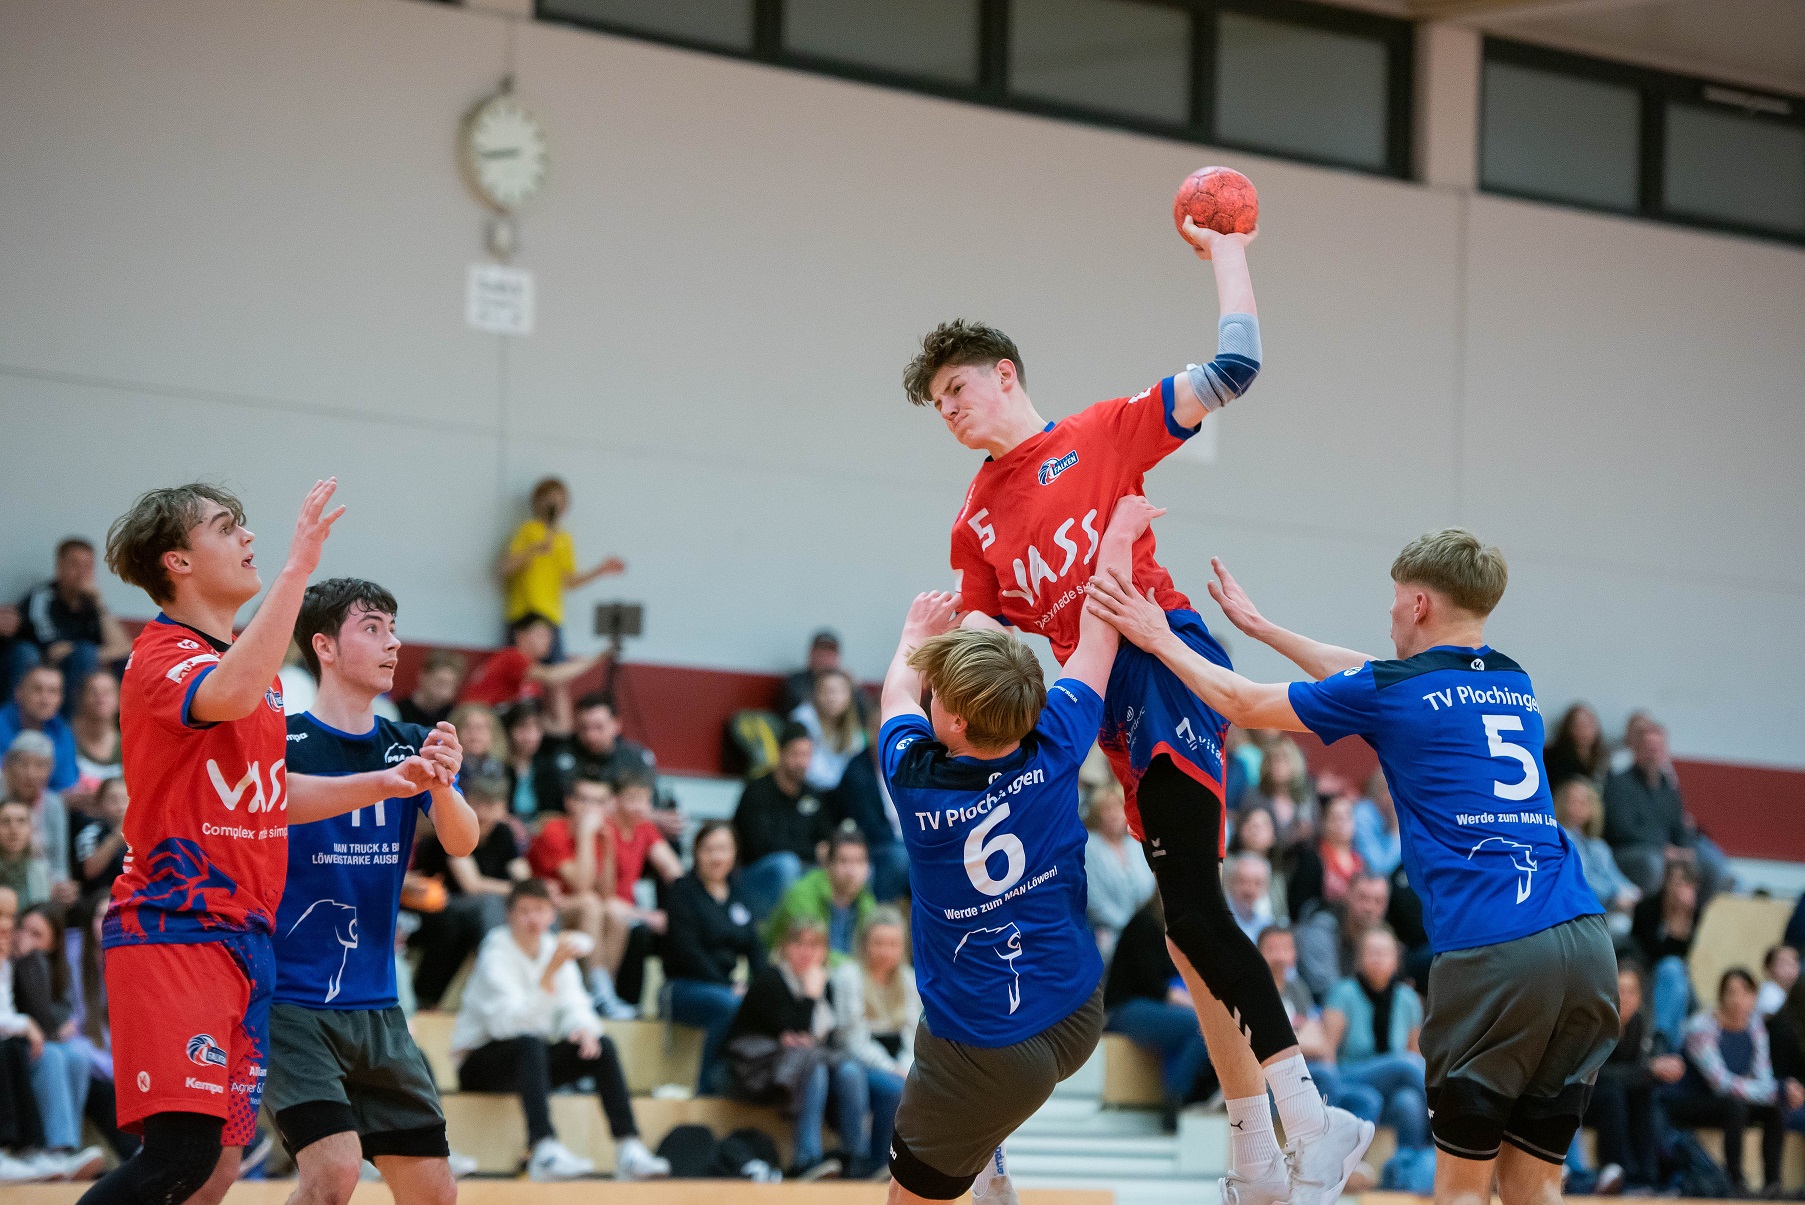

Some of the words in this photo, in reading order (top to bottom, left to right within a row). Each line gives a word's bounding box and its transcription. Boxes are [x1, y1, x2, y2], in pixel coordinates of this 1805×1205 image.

[1054, 455, 1077, 474] FALKEN
[967, 507, 996, 552] 5
[1002, 508, 1099, 607] VASS
[1423, 688, 1453, 711] TV
[1457, 686, 1542, 716] Plochinge
[1481, 714, 1540, 801] 5
[202, 822, 256, 839] Complex
[915, 810, 941, 831] TV
[1456, 812, 1495, 826] Werde
[1497, 814, 1519, 823] zum
[1521, 812, 1543, 824] MAN
[349, 843, 380, 853] TRUCK
[381, 843, 389, 853] &
[963, 801, 1026, 897] 6
[944, 906, 979, 920] Werde
[981, 897, 1003, 914] zum
[1004, 884, 1027, 901] MAN
[1027, 865, 1059, 890] Löwen!
[185, 1077, 224, 1094] Kempa
